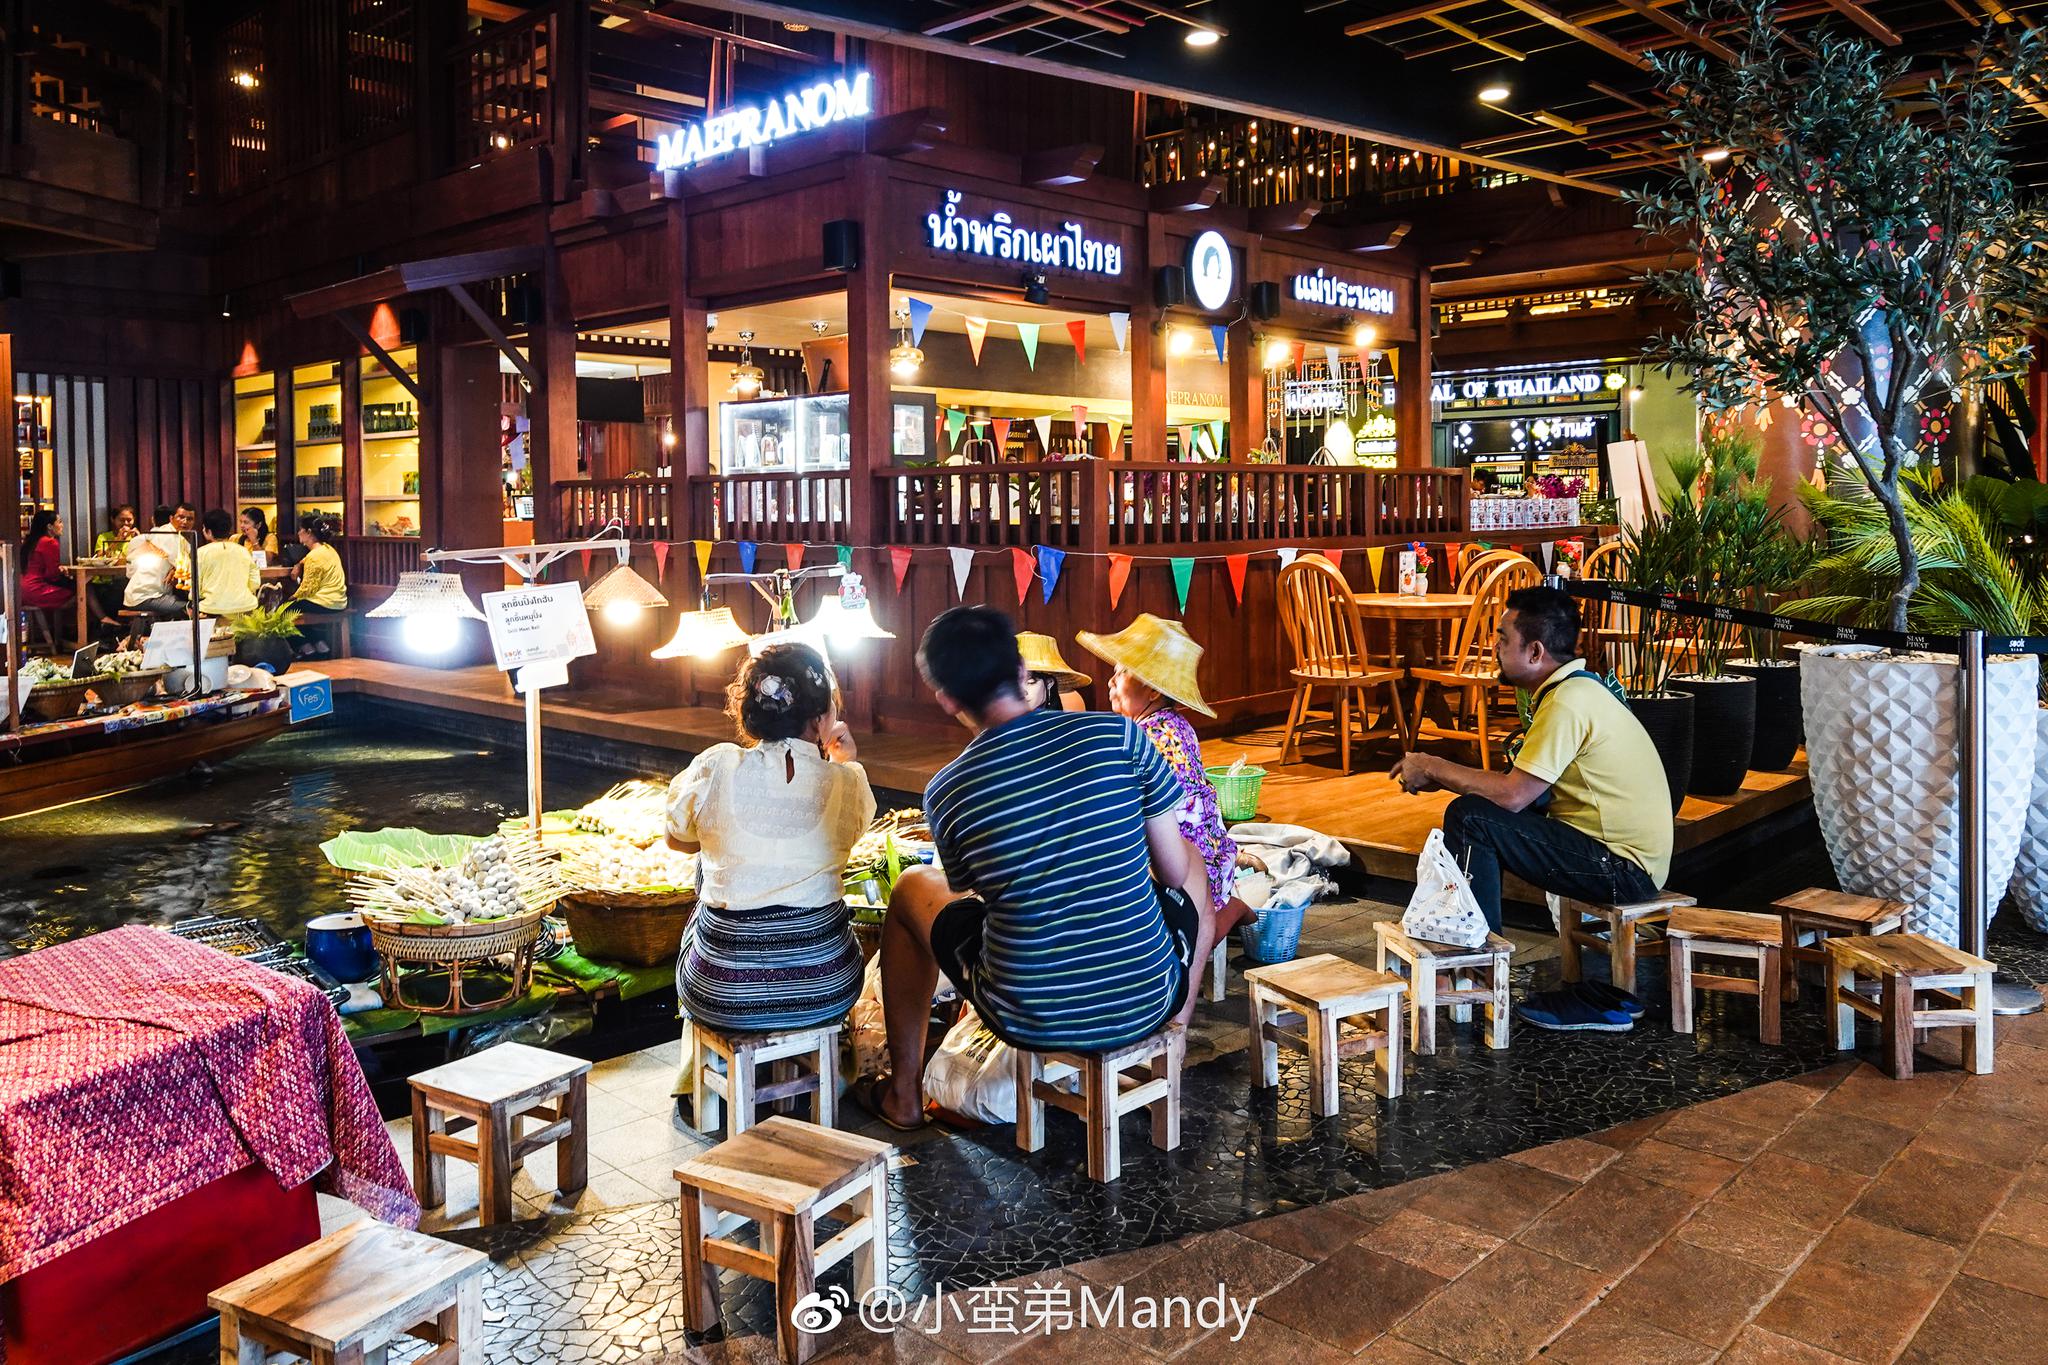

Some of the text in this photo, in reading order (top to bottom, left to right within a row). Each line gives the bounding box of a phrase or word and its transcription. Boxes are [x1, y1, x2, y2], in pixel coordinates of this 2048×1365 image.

[656, 72, 870, 172] MAEPRANOM
[927, 190, 1122, 275] น้ำพริกเผาไทย
[1294, 267, 1395, 309] แม่ประนอม
[1463, 380, 1488, 398] OF
[1494, 374, 1600, 397] THAILAND
[1836, 633, 1858, 641] PIWAT
[1906, 641, 1929, 649] PIWAT
[1907, 635, 1925, 643] SIAM
